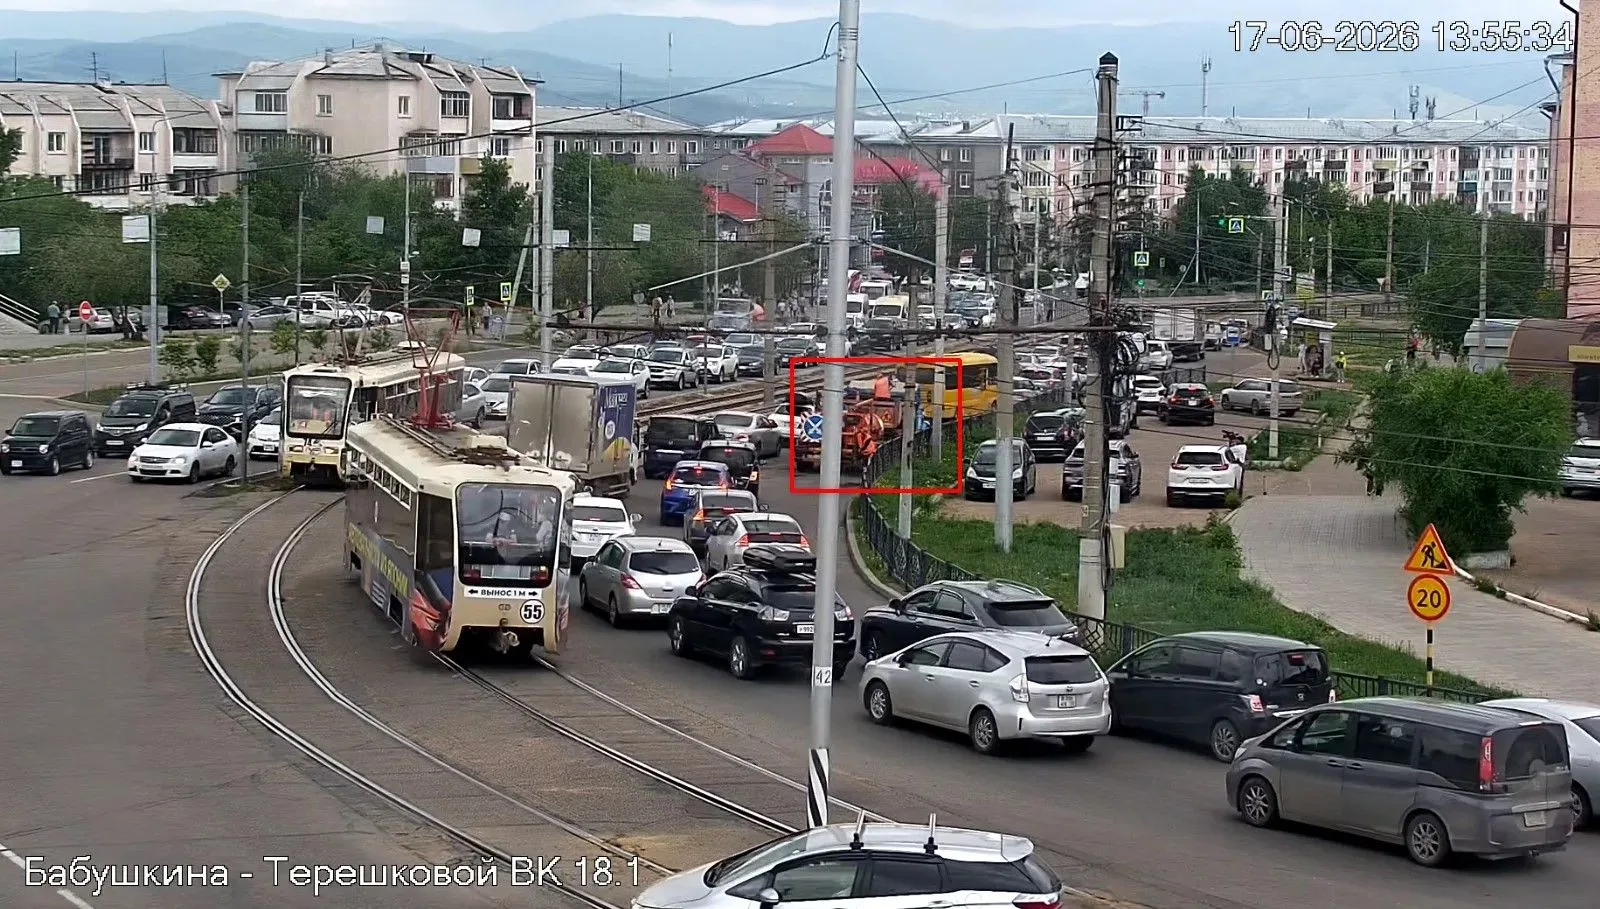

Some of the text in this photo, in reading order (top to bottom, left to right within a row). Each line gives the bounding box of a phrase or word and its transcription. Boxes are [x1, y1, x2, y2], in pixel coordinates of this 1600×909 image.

[1417, 588, 1442, 609] 20
[523, 604, 542, 620] 55
[816, 669, 831, 684] 42
